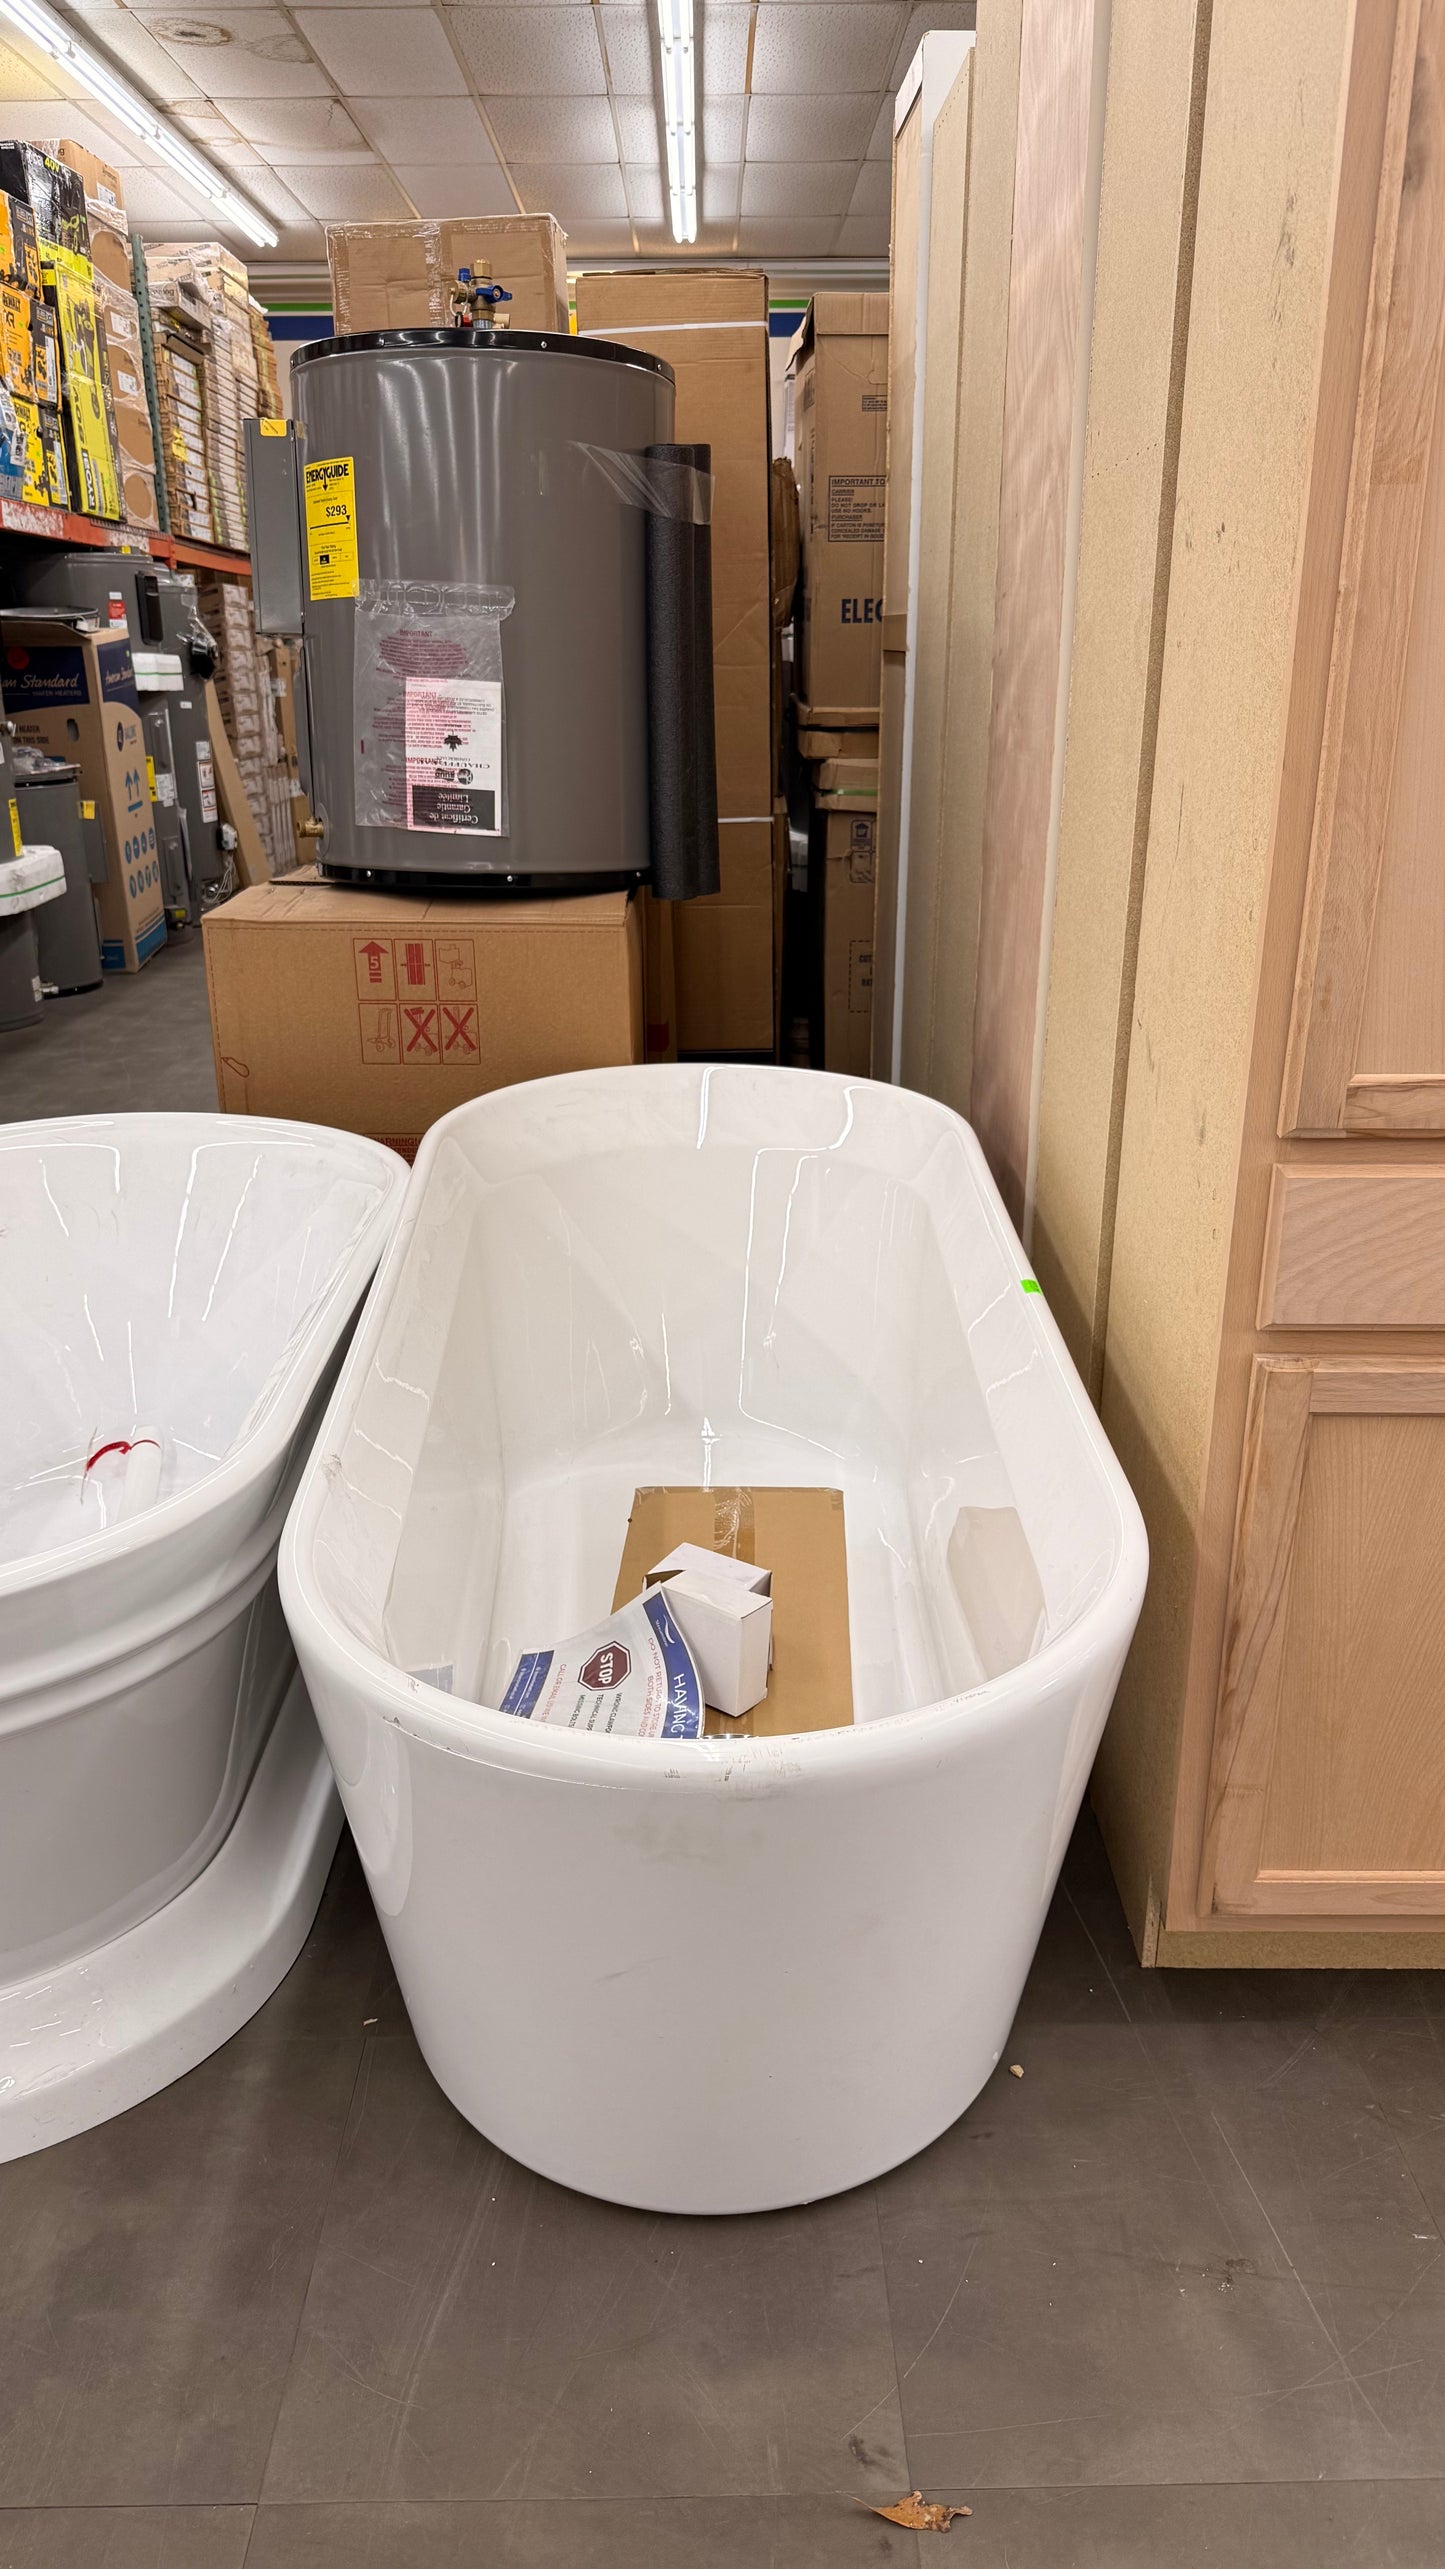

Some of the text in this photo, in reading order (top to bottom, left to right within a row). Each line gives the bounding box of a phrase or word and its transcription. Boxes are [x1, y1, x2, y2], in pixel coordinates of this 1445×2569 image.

[83, 449, 96, 508] RYOBI
[326, 505, 347, 517] $293
[20, 672, 80, 689] Standard
[429, 812, 479, 824] Certificat de
[598, 1651, 614, 1685] STOP
[654, 1651, 662, 1670] NOT
